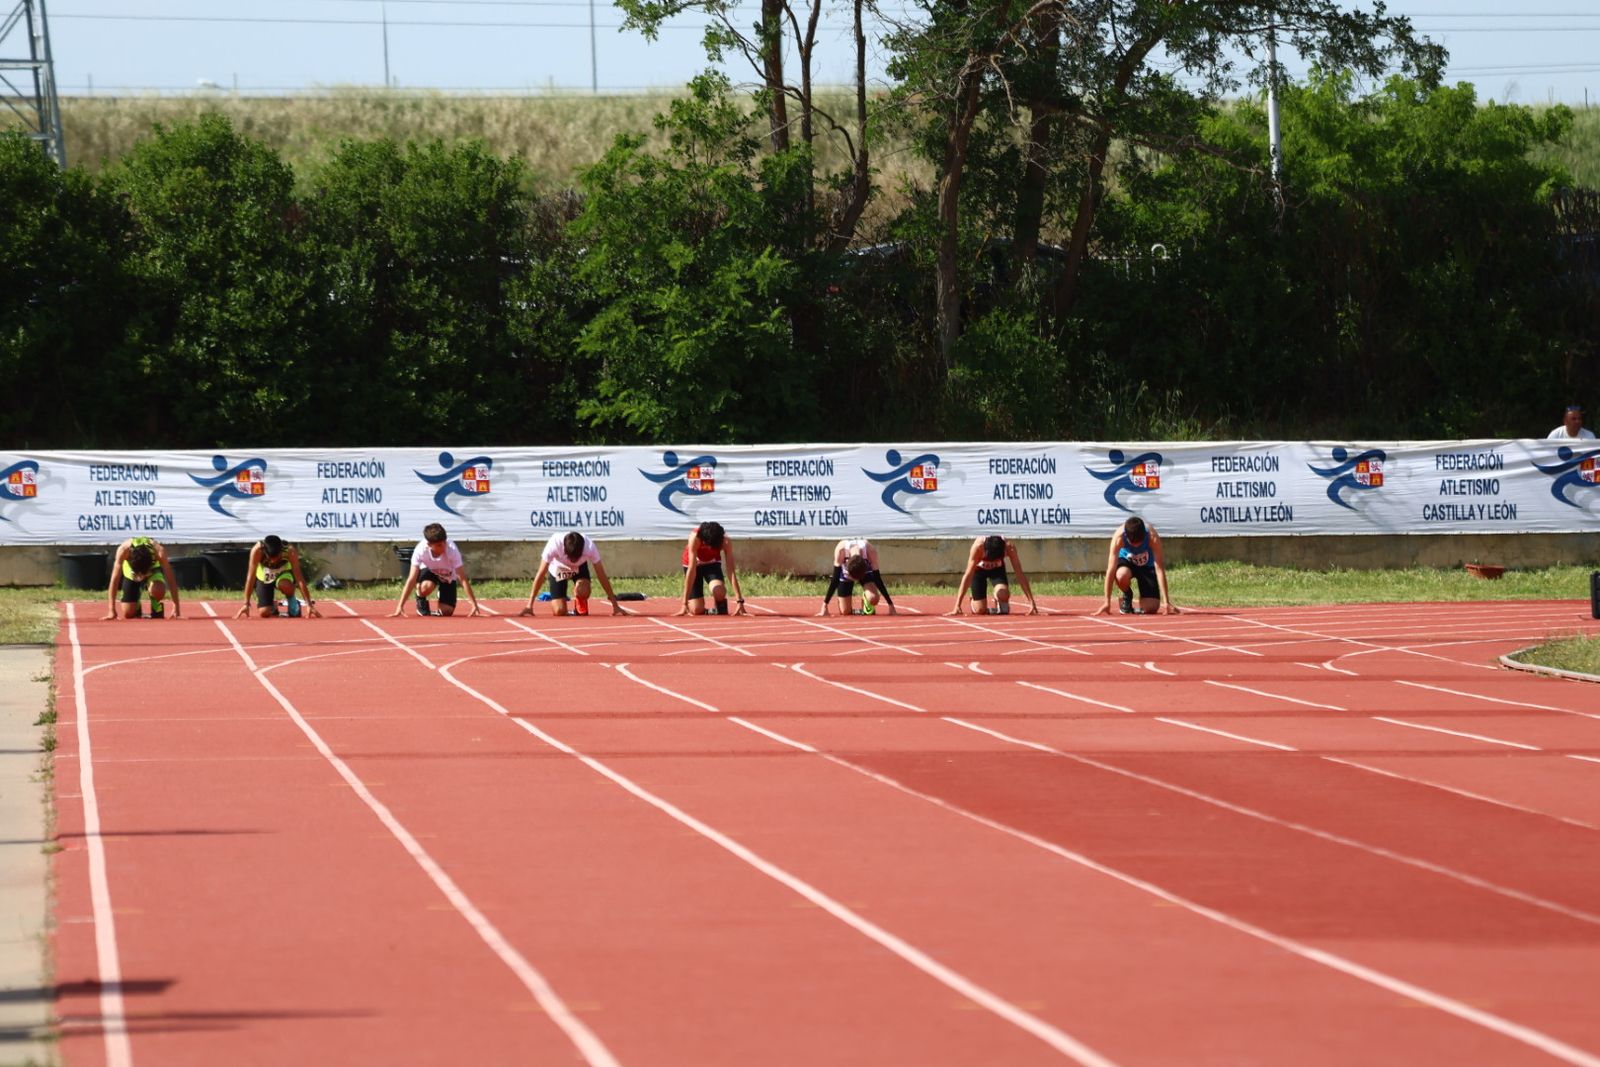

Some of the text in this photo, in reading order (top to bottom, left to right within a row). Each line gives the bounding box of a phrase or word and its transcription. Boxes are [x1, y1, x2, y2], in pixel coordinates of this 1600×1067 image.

[317, 457, 385, 478] FEDERACIÓN
[542, 456, 610, 477] FEDERACIÓN
[766, 456, 834, 476] FEDERACIÓN
[989, 453, 1056, 474] FEDERACIÓN
[1211, 451, 1279, 472] FEDERACIÓN
[1436, 449, 1503, 470] FEDERACIÓN
[90, 462, 158, 481] FEDERACIÓN
[322, 487, 382, 504] ATLETISMO
[547, 485, 607, 502] ATLETISMO
[770, 485, 831, 501] ATLETISMO
[993, 483, 1053, 500] ATLETISMO
[1216, 481, 1276, 498] ATLETISMO
[1440, 478, 1499, 495] ATLETISMO
[95, 490, 156, 506] ATLETISMO
[78, 510, 173, 531] CASTILLA Y LEÓN
[305, 508, 399, 528] CASTILLA Y LEÓN
[530, 506, 624, 527] CASTILLA Y LEÓN
[754, 506, 848, 526] CASTILLA Y LEÓN
[977, 504, 1071, 525] CASTILLA Y LEÓN
[1200, 502, 1293, 523] CASTILLA Y LEÓN
[1423, 500, 1517, 521] CASTILLA Y LEÓN
